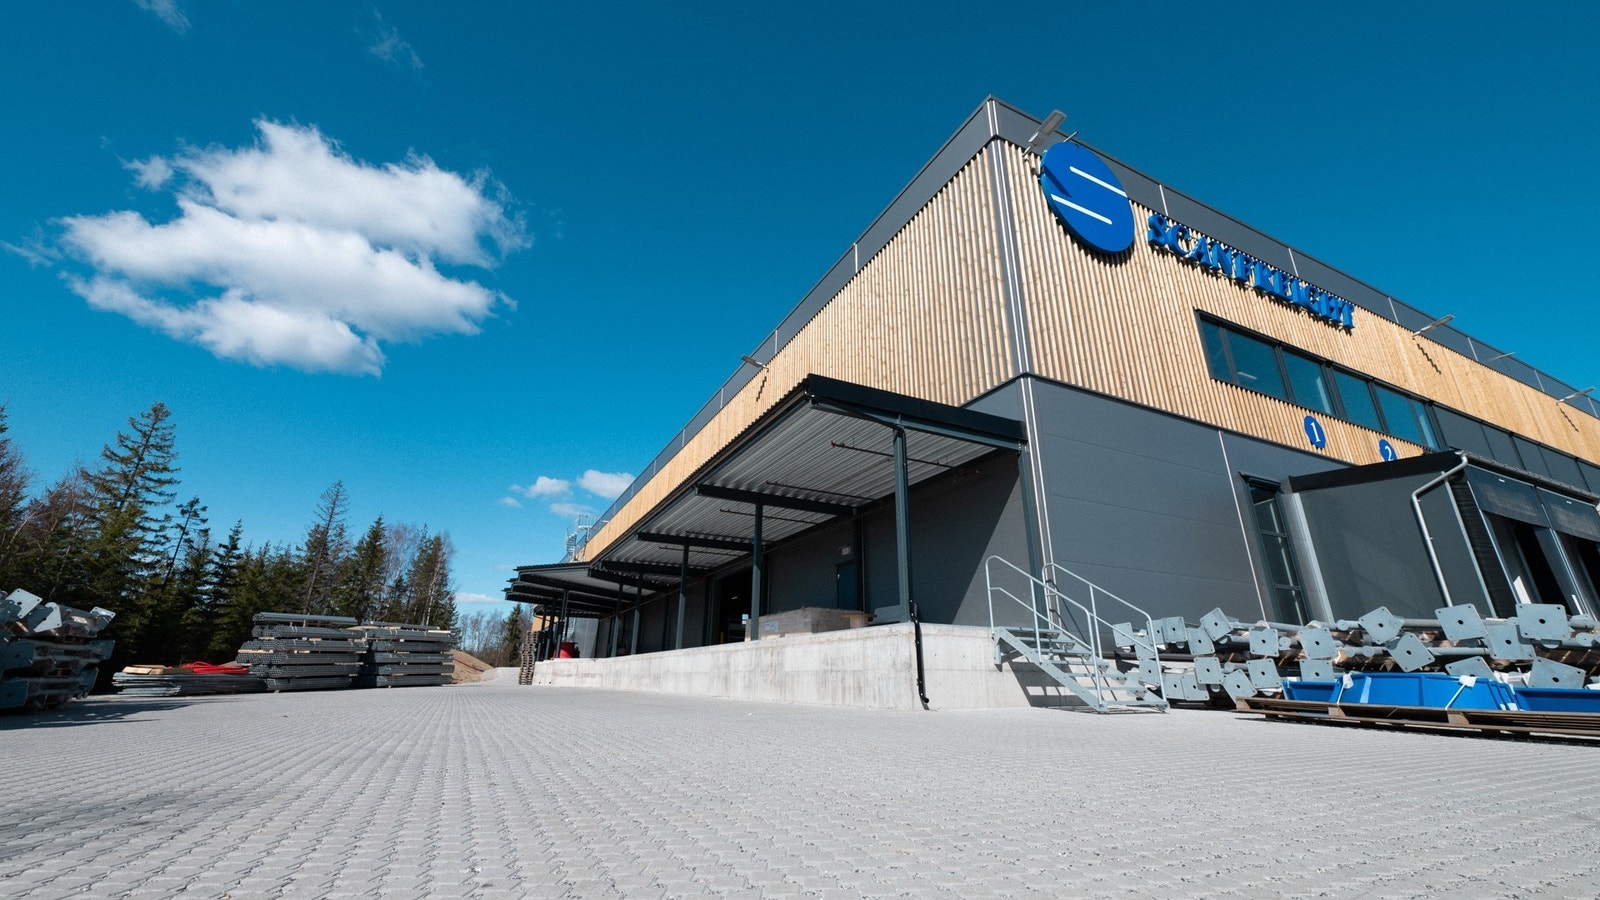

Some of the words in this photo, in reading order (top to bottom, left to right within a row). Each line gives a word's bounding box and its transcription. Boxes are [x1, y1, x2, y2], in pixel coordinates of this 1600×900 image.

[1147, 213, 1355, 329] SCANFREIGHT
[1310, 421, 1321, 443] 1
[1384, 445, 1394, 461] 2
